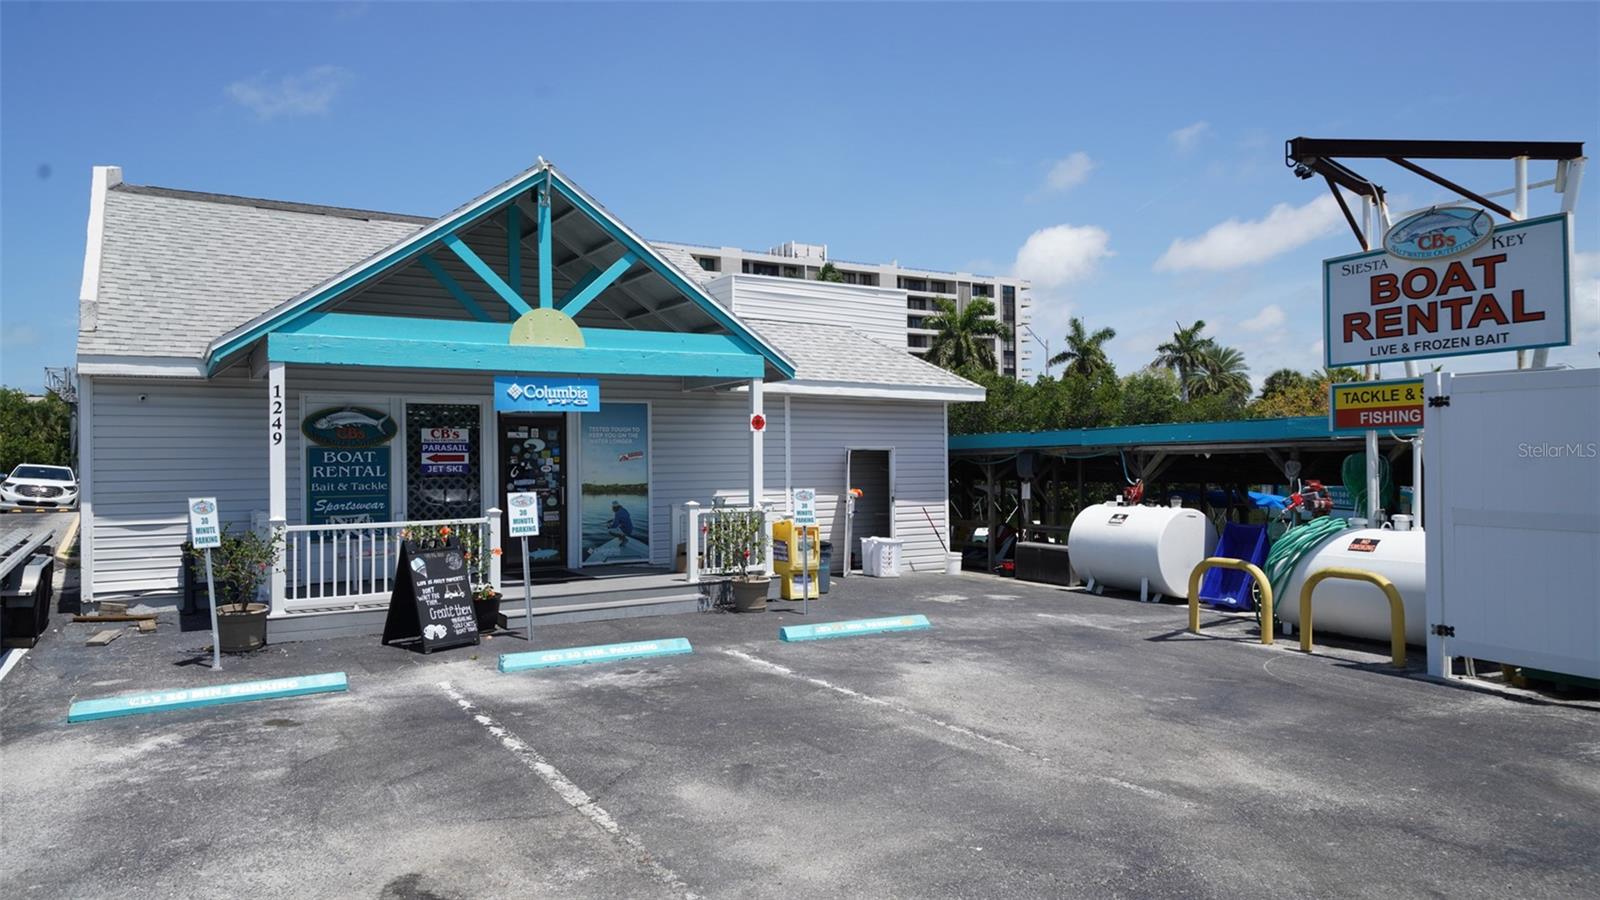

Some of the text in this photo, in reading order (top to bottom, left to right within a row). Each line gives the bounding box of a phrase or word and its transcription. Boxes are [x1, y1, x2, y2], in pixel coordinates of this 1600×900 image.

[1491, 232, 1527, 250] KEY
[1341, 260, 1389, 277] SIESTA
[1370, 253, 1508, 306] BOAT
[1343, 289, 1546, 343] RENTAL
[1370, 332, 1510, 357] LIVE & FROZEN BAIT
[523, 383, 589, 399] Columbia
[1343, 388, 1400, 404] TACKLE
[1405, 387, 1416, 401] &
[271, 384, 283, 446] 1249
[1360, 408, 1422, 424] FISHING
[431, 428, 460, 439] CB's
[422, 444, 468, 452] PARASAIL
[324, 451, 377, 463] BOAT
[312, 465, 387, 478] RENTAL
[427, 465, 463, 473] JET SKI
[311, 481, 388, 491] Bait & Tackle
[313, 499, 386, 514] Sportswear
[200, 516, 209, 525] 30
[195, 526, 216, 535] MINUTE
[511, 525, 537, 533] PARKING
[194, 535, 219, 545] PARKING
[429, 604, 456, 620] Create
